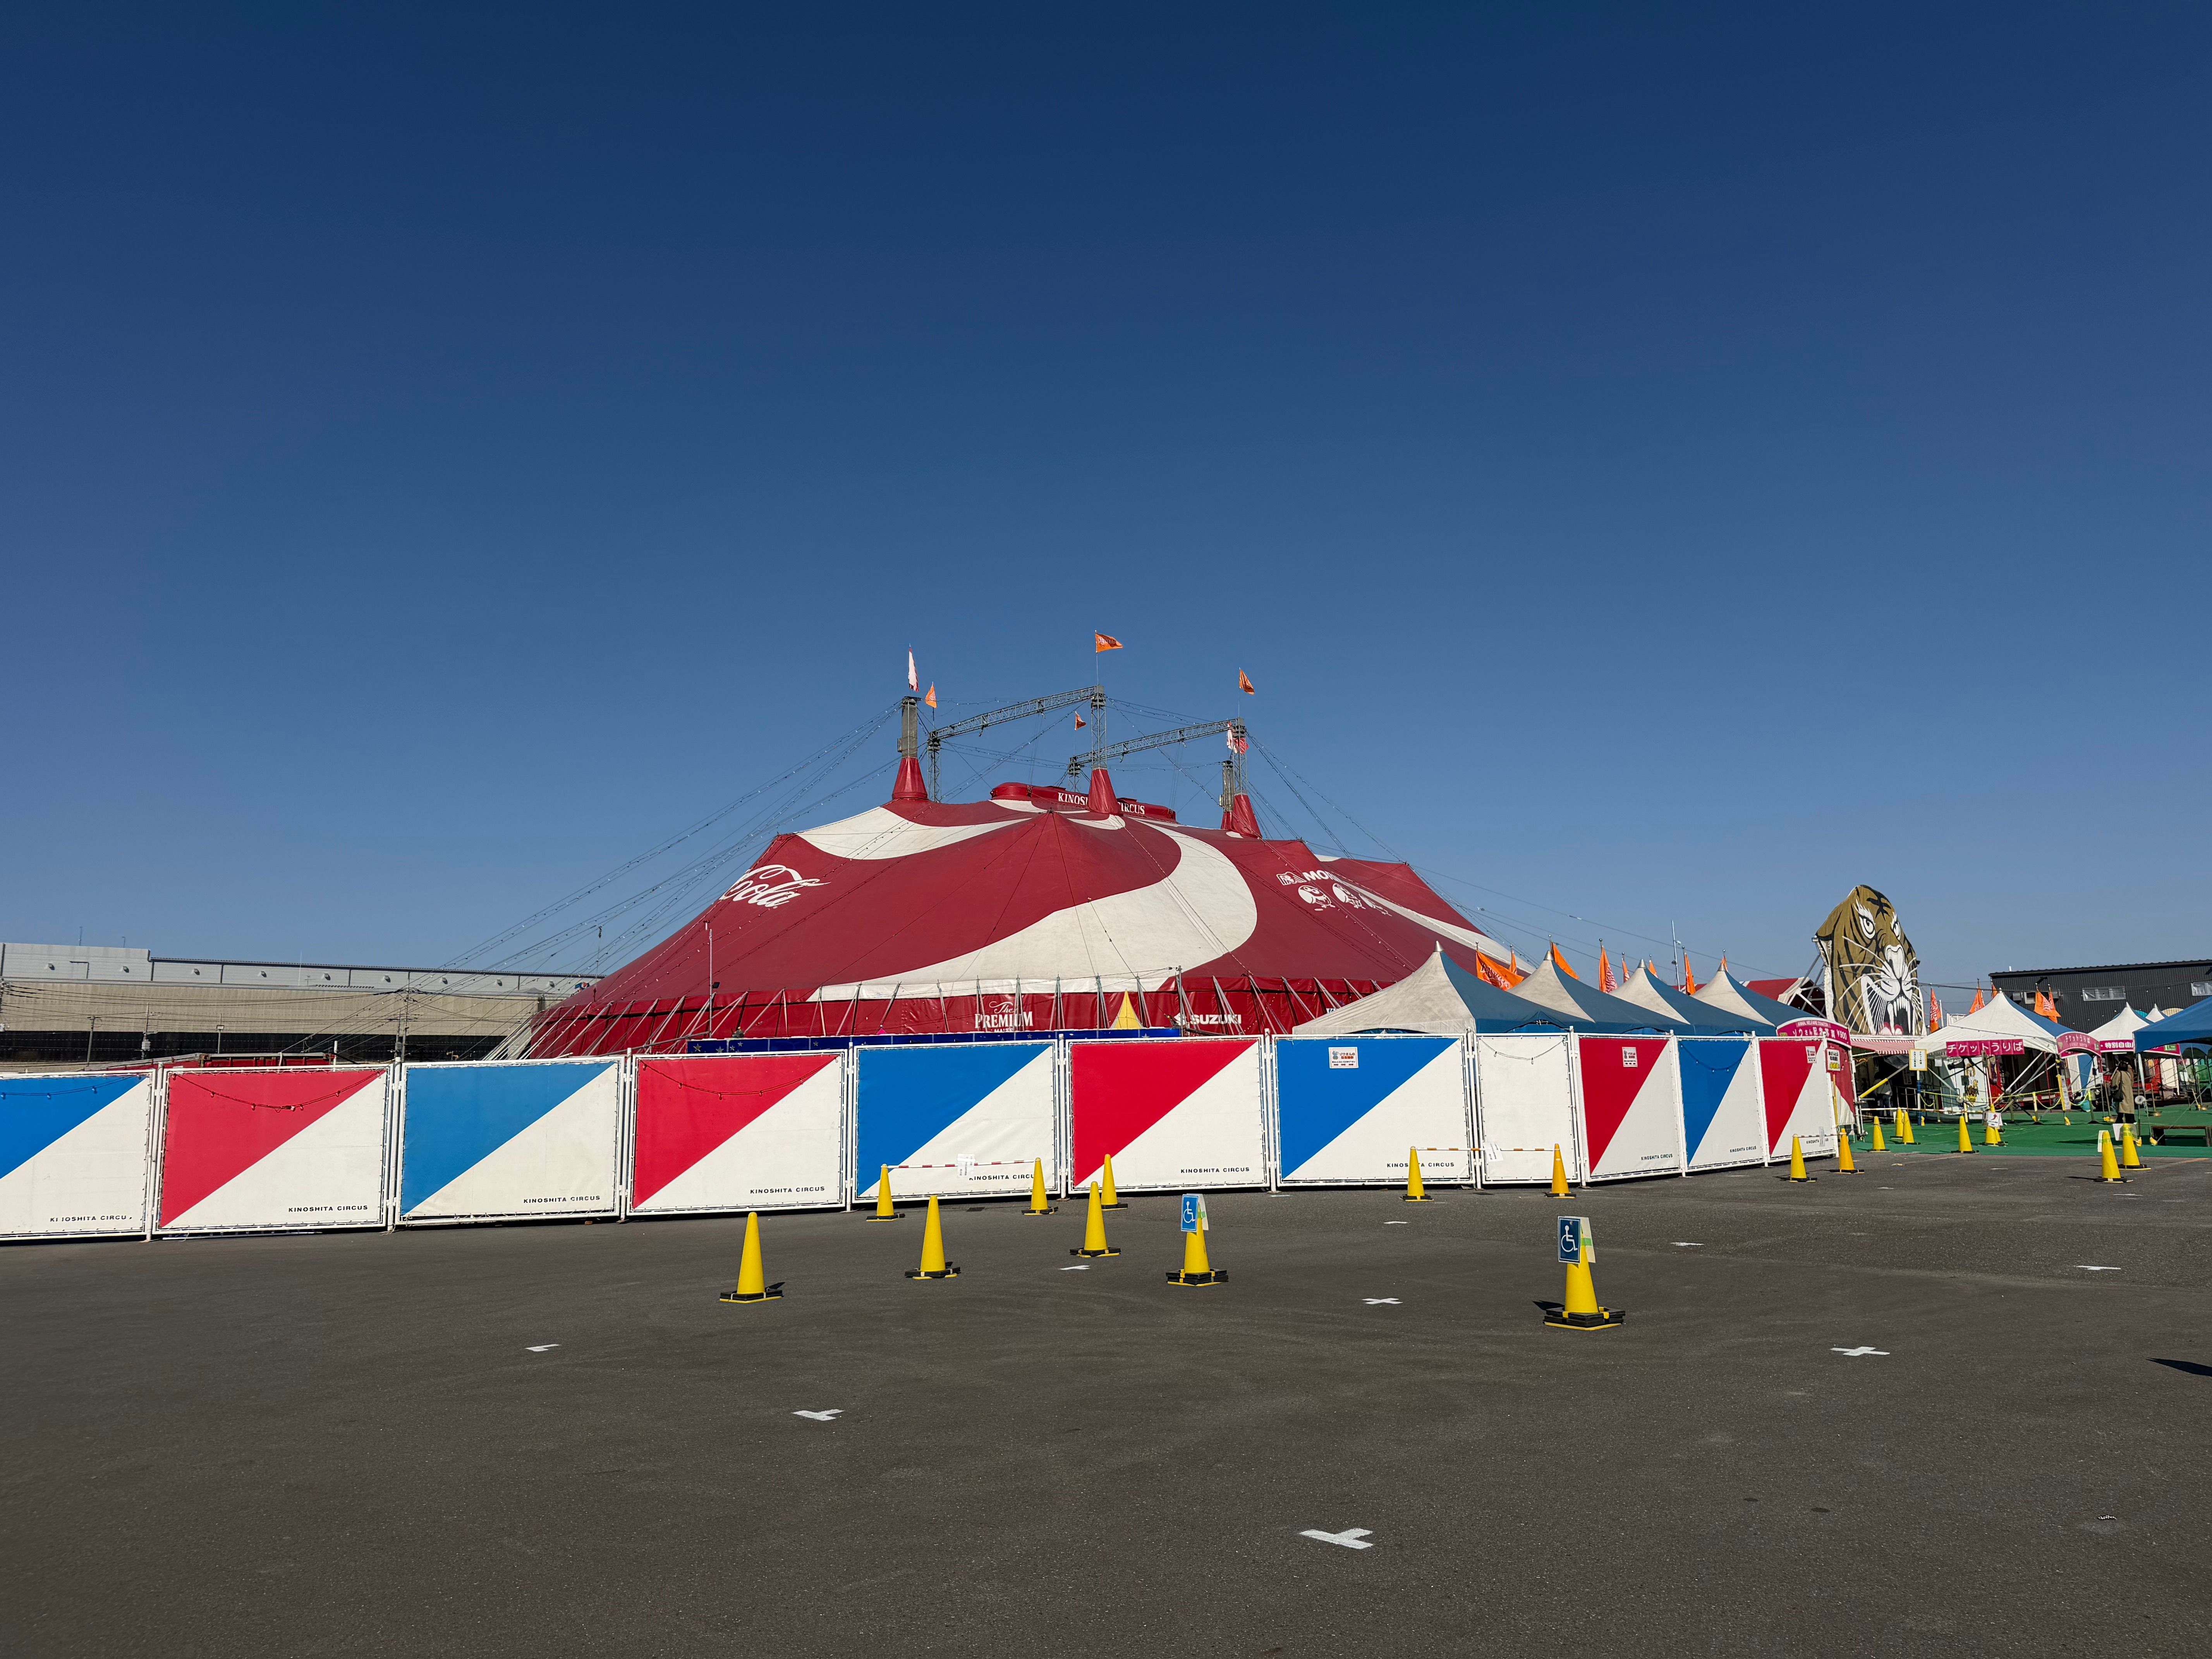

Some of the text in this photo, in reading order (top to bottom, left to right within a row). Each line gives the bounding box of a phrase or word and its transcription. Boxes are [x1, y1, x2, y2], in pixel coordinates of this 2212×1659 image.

[1058, 792, 1088, 805] KINOS
[719, 864, 831, 907] Cola
[989, 1001, 1018, 1013] The
[975, 1011, 1034, 1029] PREMIUM
[1190, 1014, 1242, 1025] SUZUKI
[1947, 1041, 2023, 1053] チケットうりば
